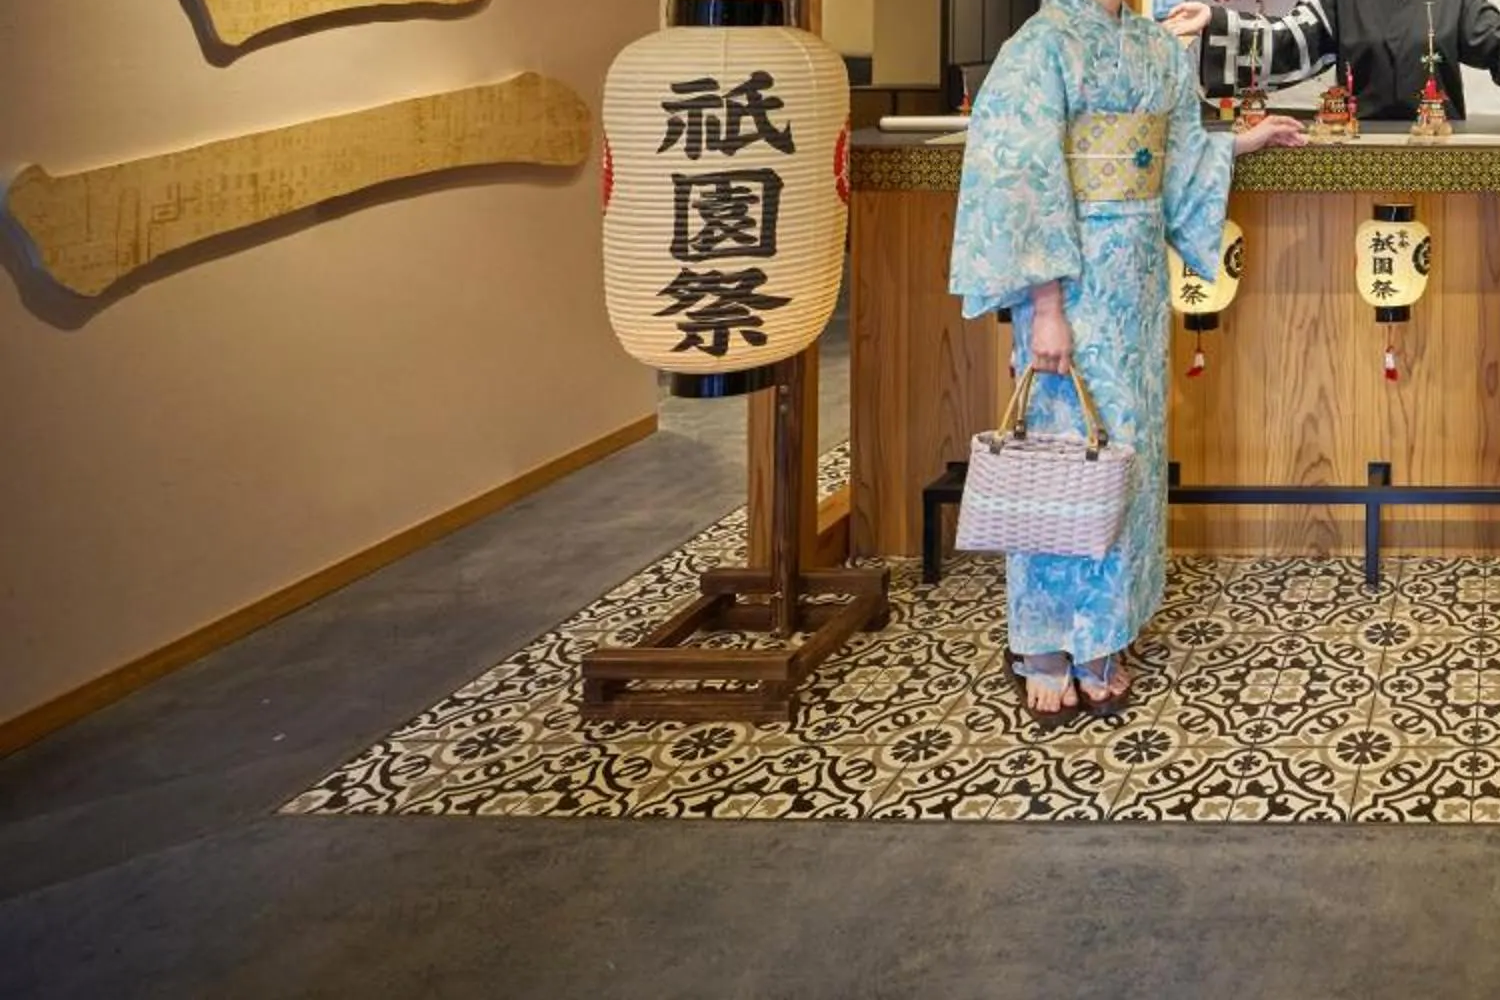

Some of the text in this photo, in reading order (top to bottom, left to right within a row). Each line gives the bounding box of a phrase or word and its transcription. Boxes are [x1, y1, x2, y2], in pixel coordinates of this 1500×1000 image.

[652, 70, 796, 357] 祇園祭
[1369, 231, 1400, 300] 祇園祭
